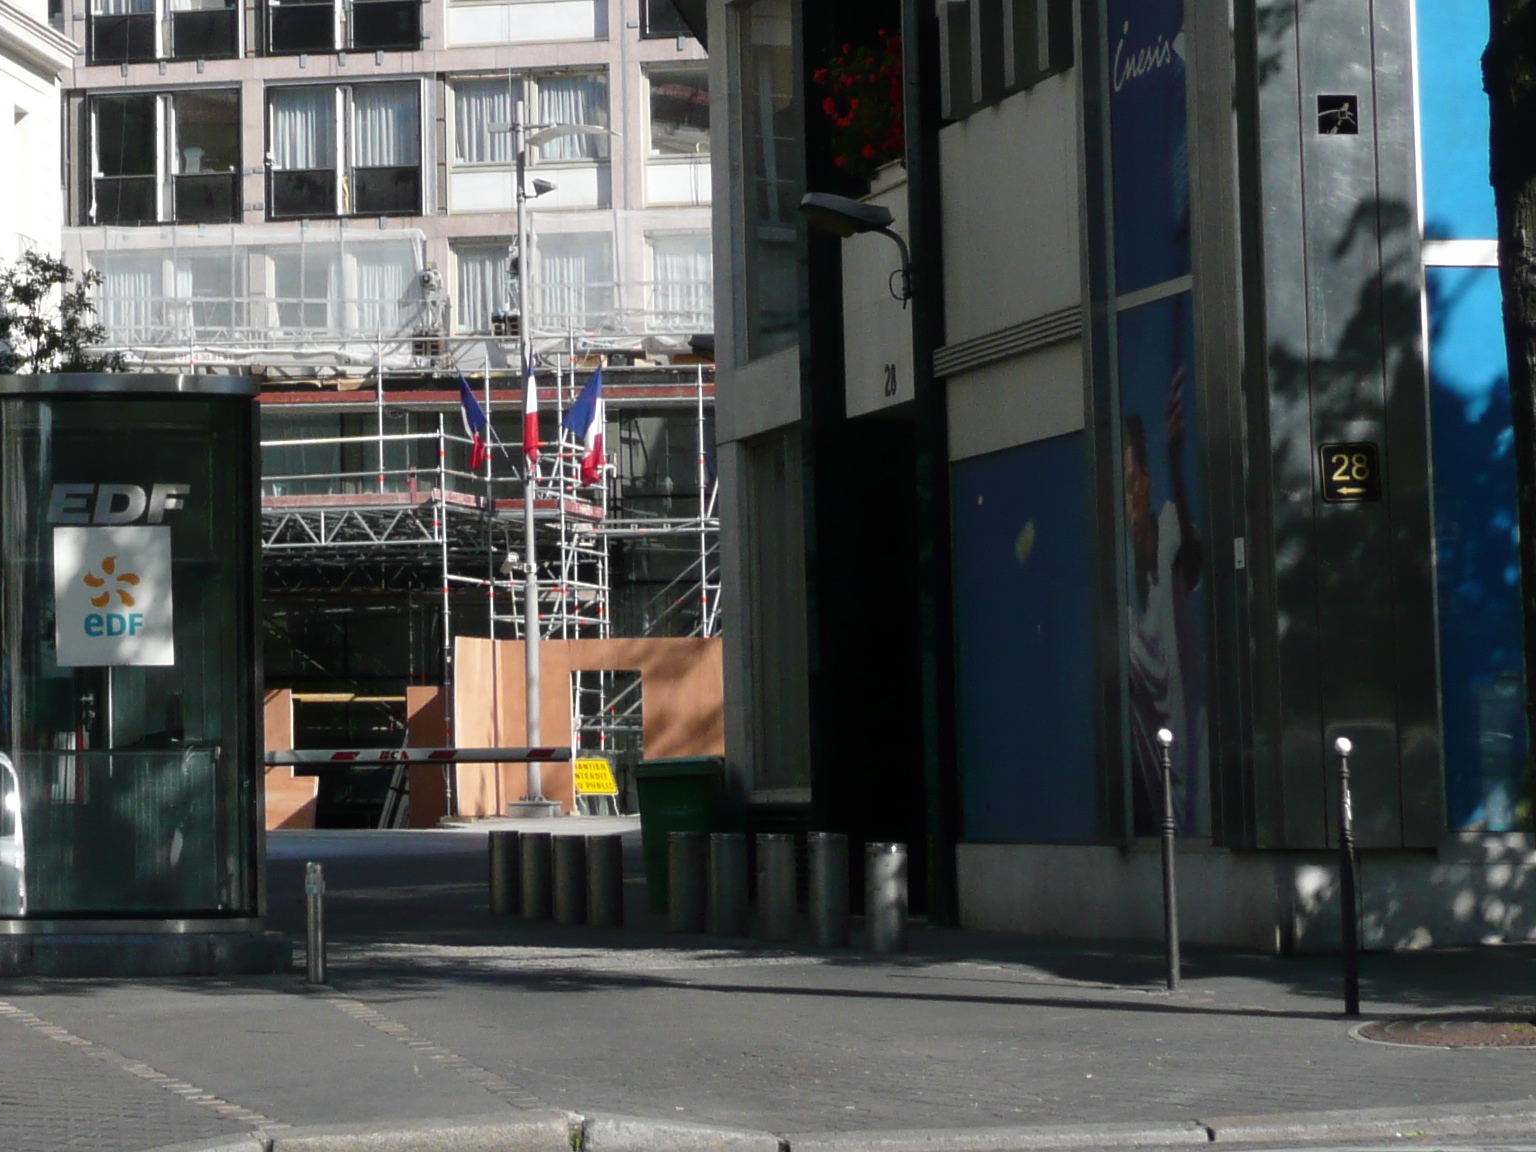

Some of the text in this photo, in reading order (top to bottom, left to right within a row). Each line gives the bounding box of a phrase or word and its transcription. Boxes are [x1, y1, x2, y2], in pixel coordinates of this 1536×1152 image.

[884, 363, 897, 397] 28
[1331, 453, 1370, 481] 28
[46, 483, 190, 524] EDF
[379, 750, 410, 760] BCA
